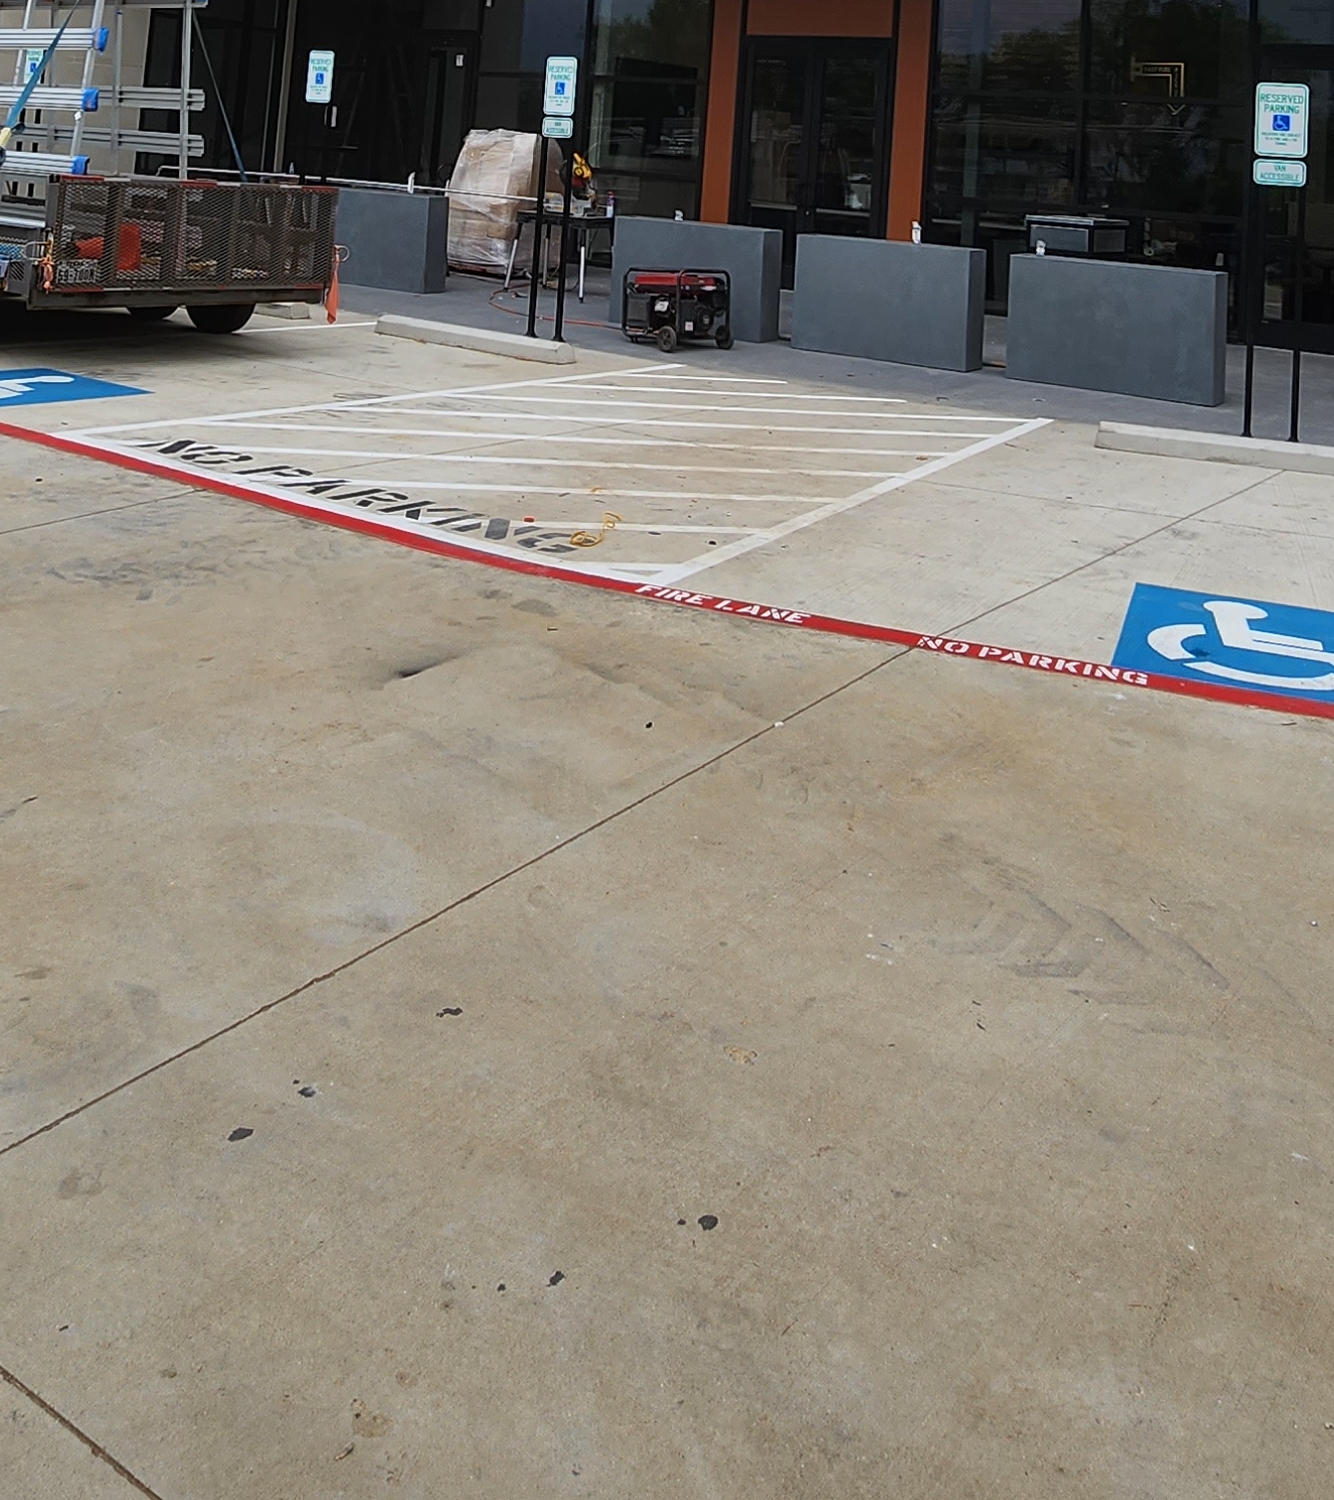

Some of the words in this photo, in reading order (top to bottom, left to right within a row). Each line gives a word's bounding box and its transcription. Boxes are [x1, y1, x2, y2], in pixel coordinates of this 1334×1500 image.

[1260, 93, 1304, 105] RESERVED
[1264, 104, 1299, 114] PARKING
[136, 439, 253, 465] NO
[233, 464, 592, 554] PARKING
[635, 584, 713, 606] FIRE
[714, 600, 811, 624] LANE
[917, 635, 970, 654] NO
[977, 646, 1149, 686] PARKING
